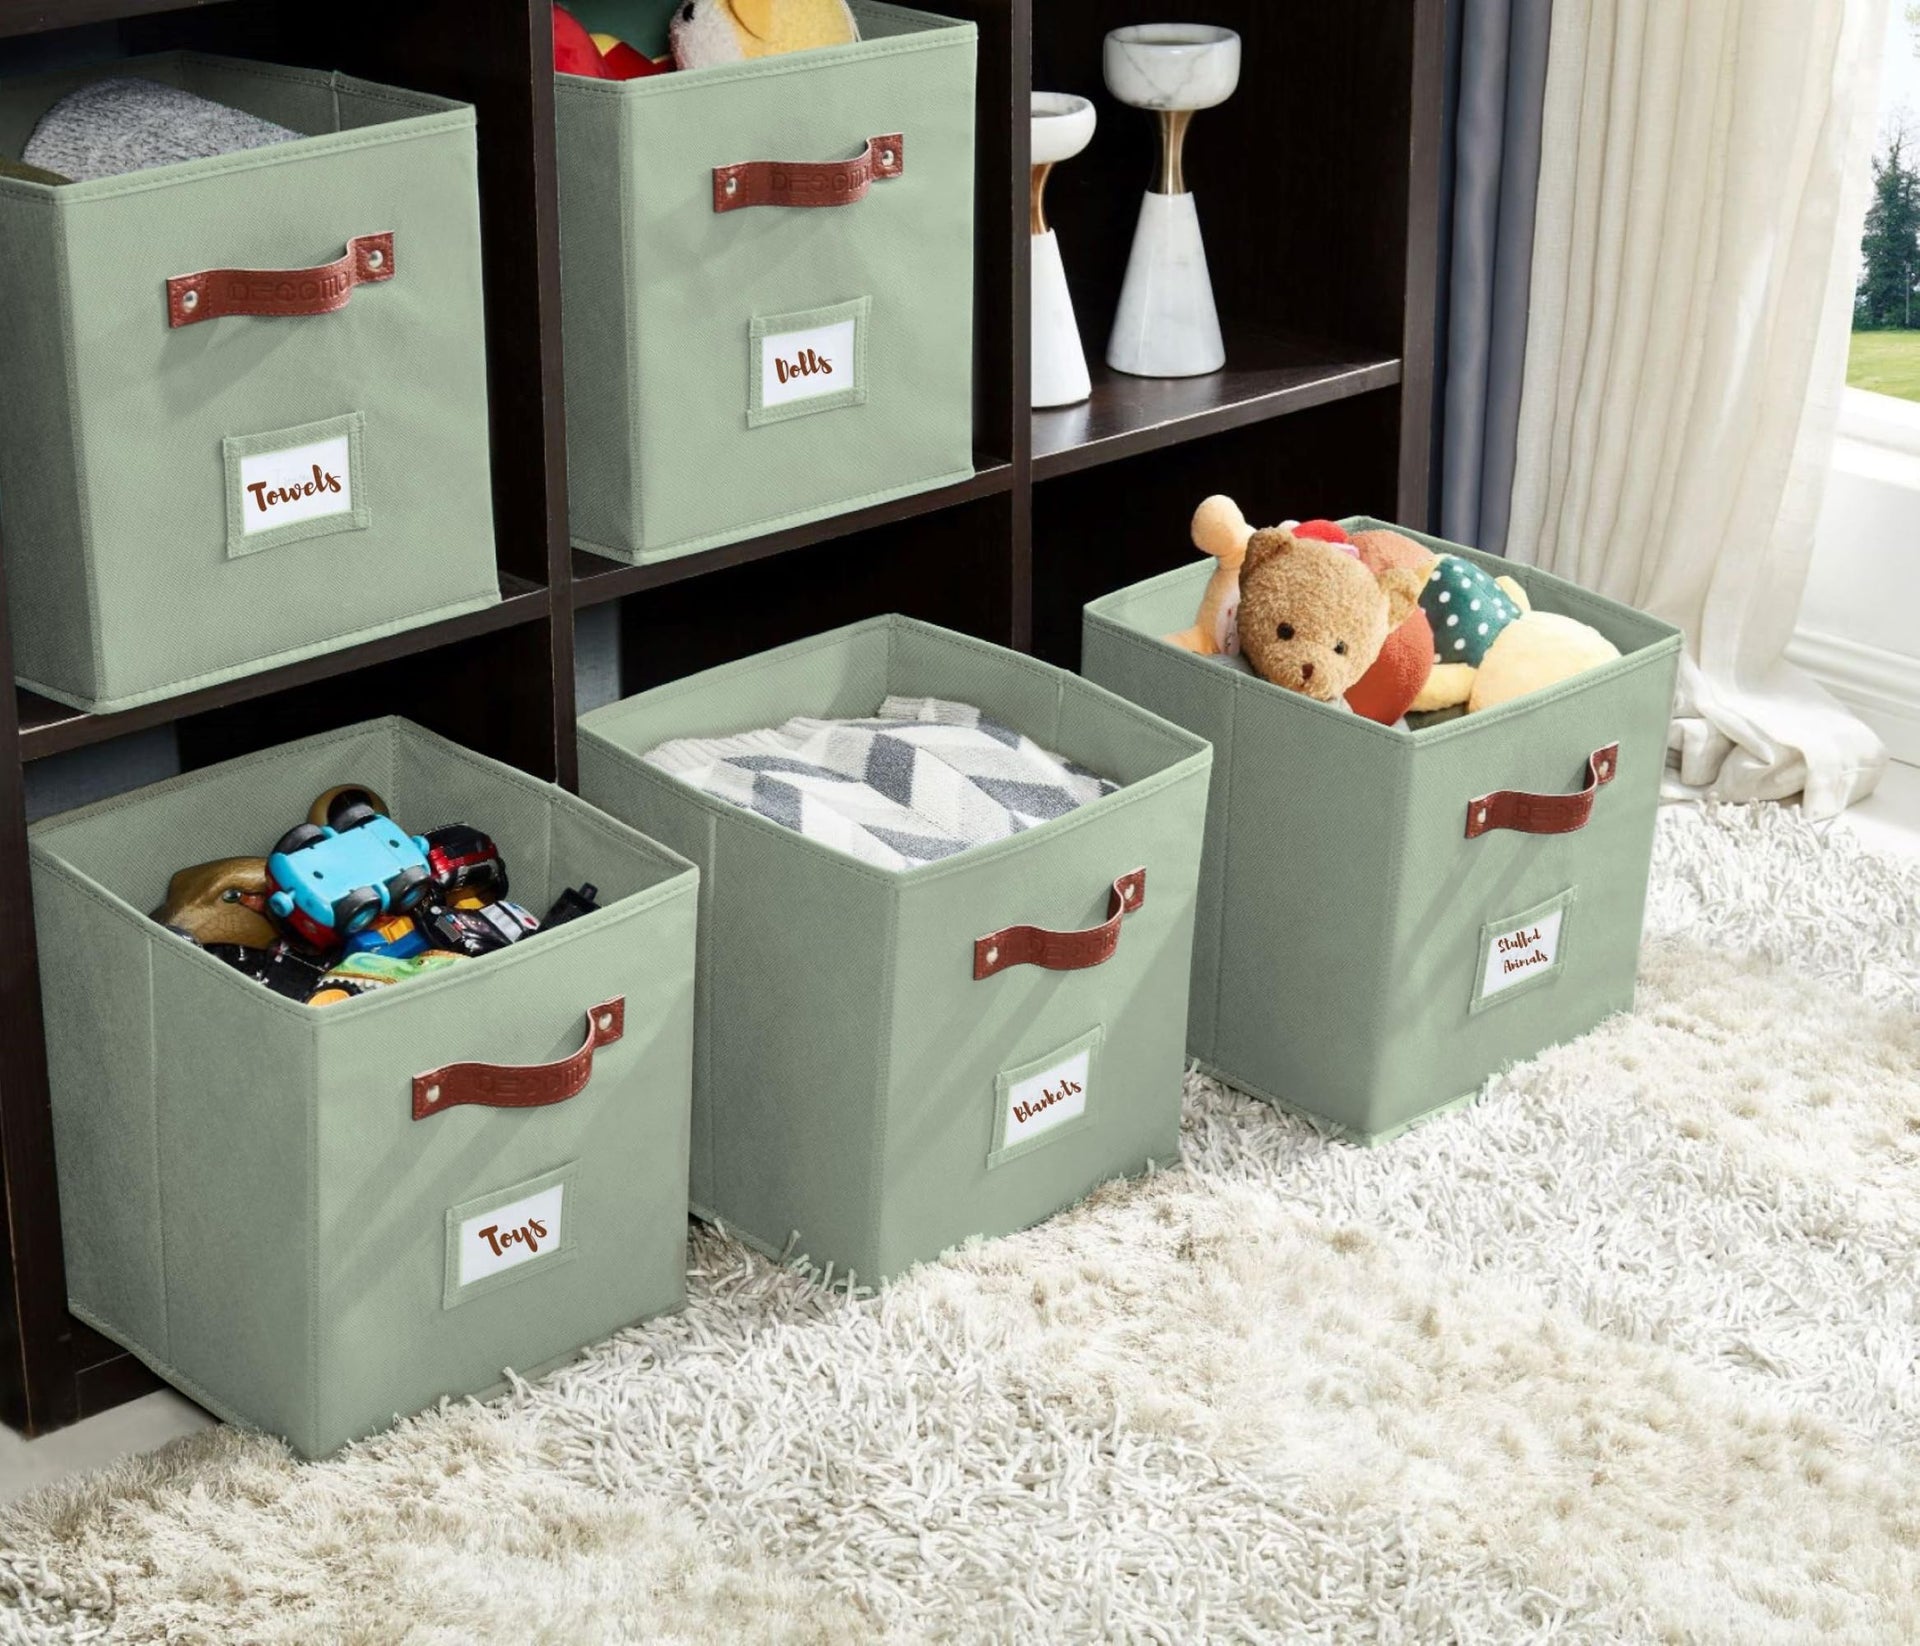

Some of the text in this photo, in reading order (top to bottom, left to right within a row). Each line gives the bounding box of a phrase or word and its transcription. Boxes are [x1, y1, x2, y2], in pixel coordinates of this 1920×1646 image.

[774, 348, 833, 384] Dolls
[246, 464, 342, 513] Towels
[1498, 928, 1541, 953] Stuffed
[1504, 949, 1549, 974] Animals
[1013, 1080, 1082, 1123] Blankets
[478, 1218, 548, 1257] Toys
